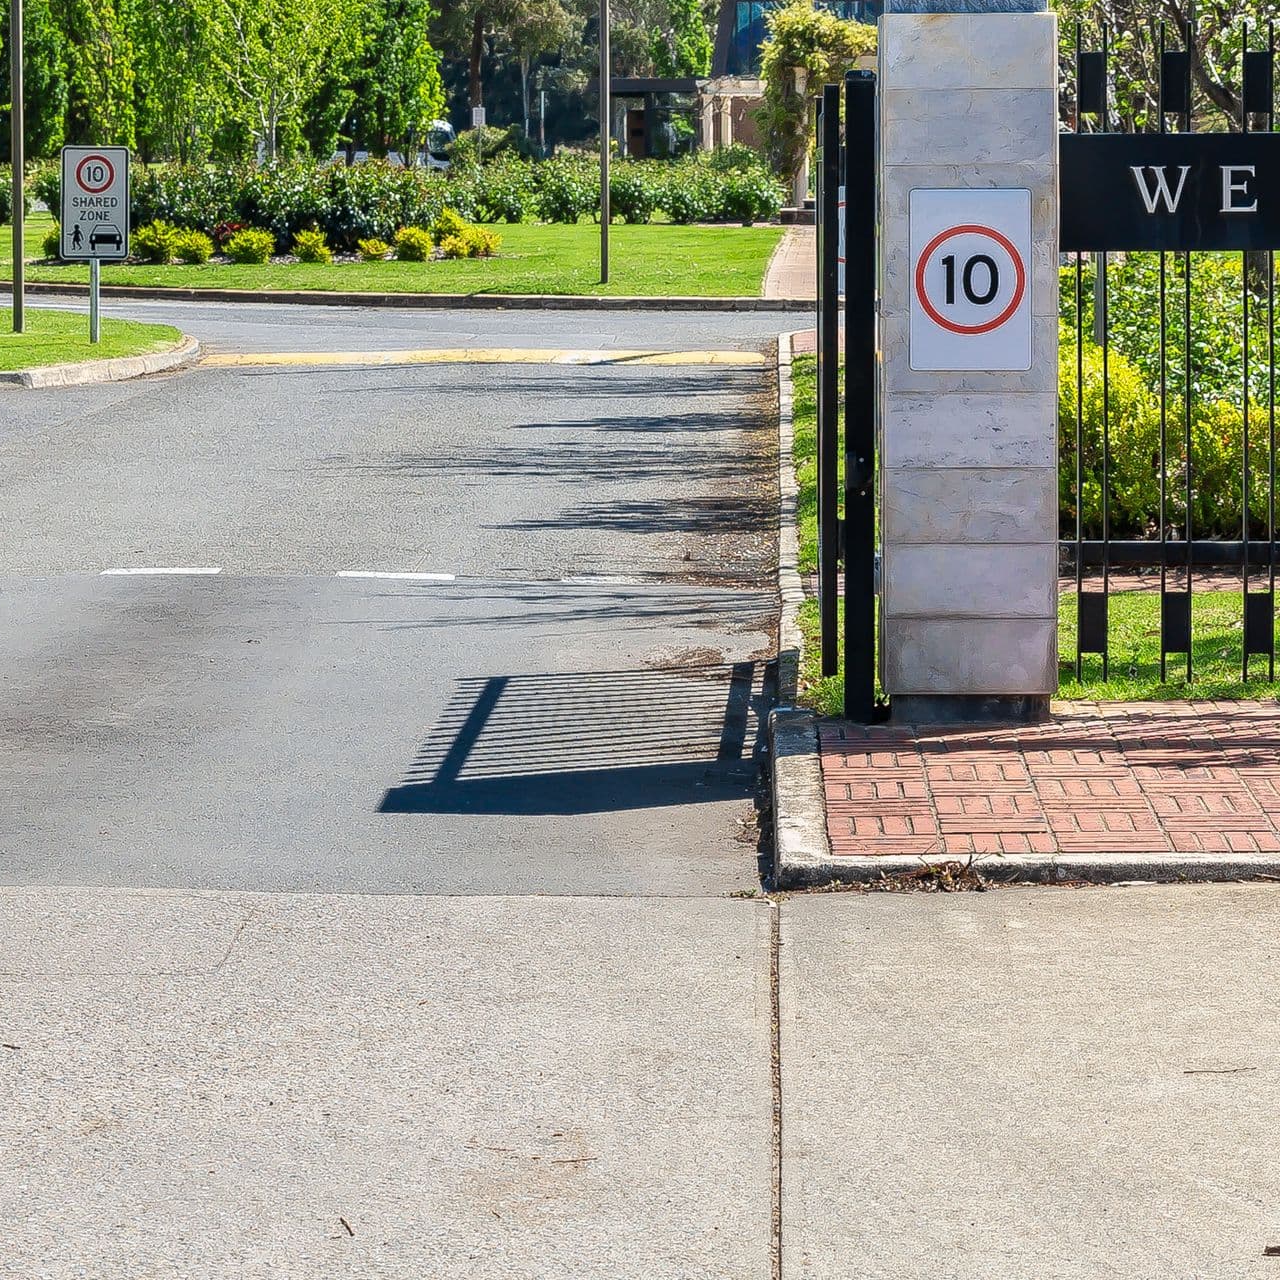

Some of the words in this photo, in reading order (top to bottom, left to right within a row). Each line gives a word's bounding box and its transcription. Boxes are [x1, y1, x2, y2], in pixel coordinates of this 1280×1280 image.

[86, 166, 104, 182] 10
[72, 197, 118, 208] SHARED
[80, 211, 110, 221] ZONE
[941, 254, 999, 305] 10
